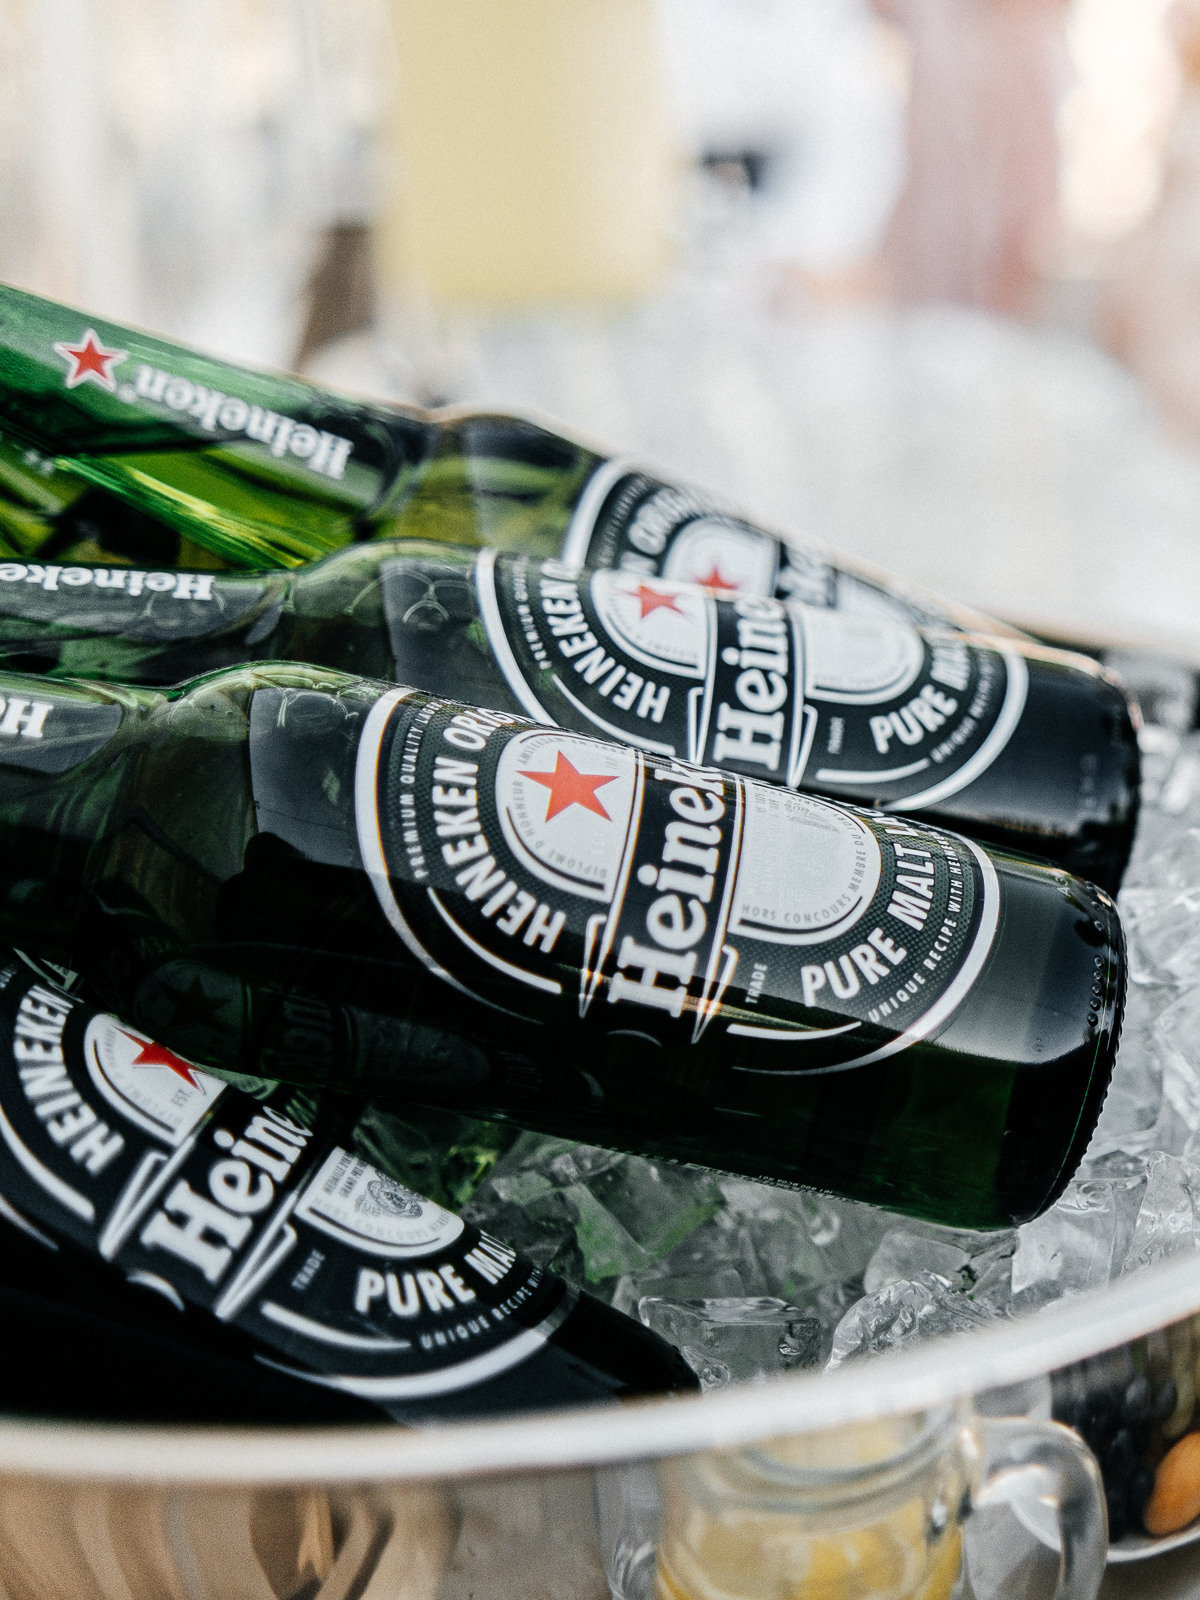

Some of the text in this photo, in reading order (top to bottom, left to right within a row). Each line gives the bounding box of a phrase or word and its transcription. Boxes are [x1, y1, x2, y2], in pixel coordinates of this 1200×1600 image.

[134, 363, 355, 480] Heineken
[400, 726, 423, 784] QUALITY
[868, 683, 958, 754] PURE
[400, 793, 429, 879] PREMIUM
[431, 707, 566, 953] HEINEKEN ORIG
[742, 904, 776, 920] HORS
[784, 893, 851, 923] CONCOURS
[848, 849, 866, 893] MEMBRE
[801, 927, 907, 1007] PURE
[887, 842, 934, 931] MALT
[745, 962, 768, 1004] TRADE
[868, 972, 926, 1023] UNIQUE
[923, 917, 957, 971] RECIPE
[947, 879, 963, 913] WITH
[13, 984, 125, 1177] HEINEKEN
[354, 1229, 517, 1318] PURE MAL
[419, 1315, 490, 1350] UNIQUE
[490, 1286, 533, 1321] RECIPE
